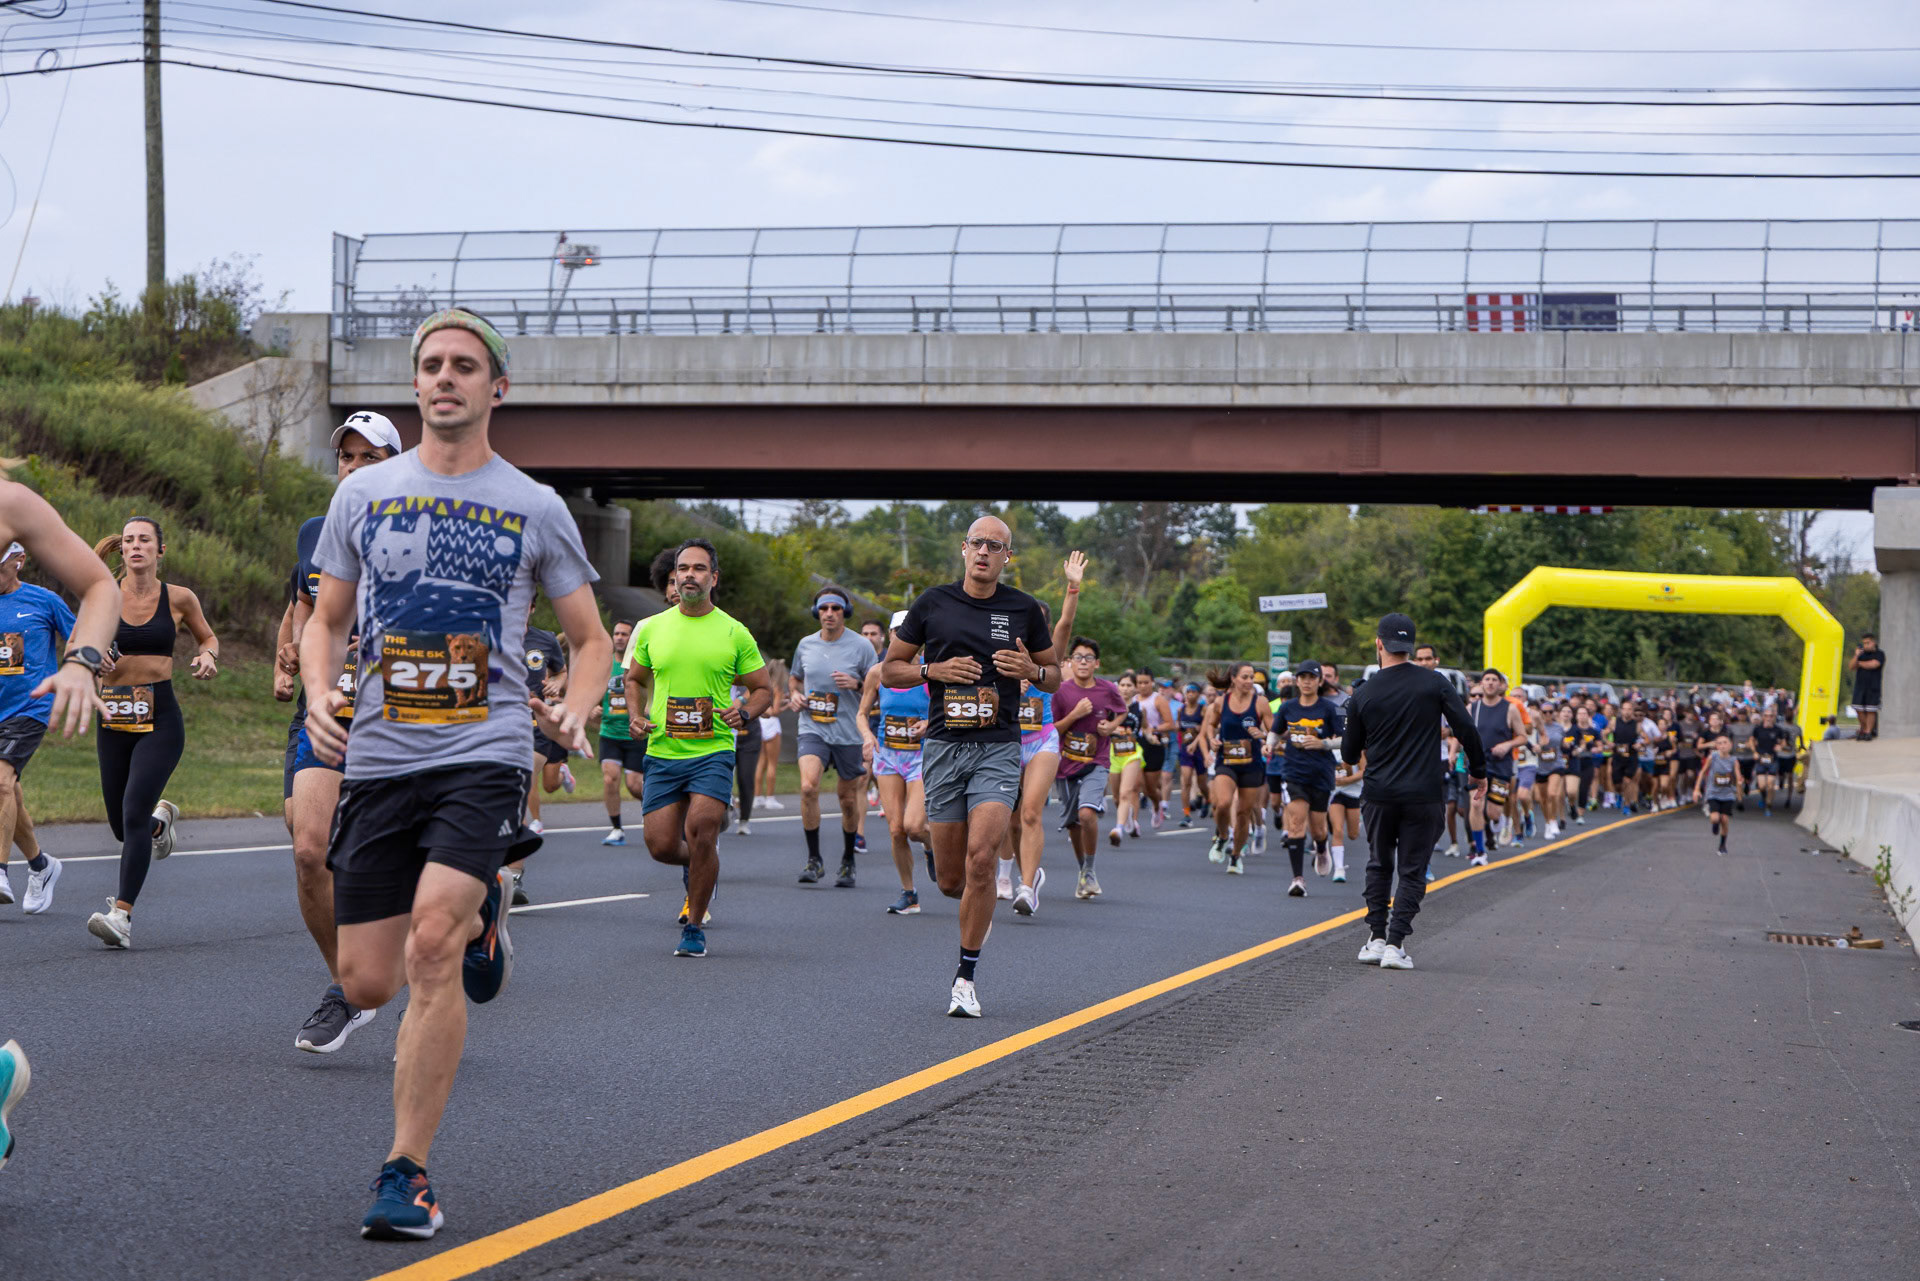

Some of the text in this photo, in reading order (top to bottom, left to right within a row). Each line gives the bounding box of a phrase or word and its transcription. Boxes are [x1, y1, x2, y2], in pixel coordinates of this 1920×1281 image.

[1262, 599, 1273, 608] 24
[384, 635, 407, 645] THE
[383, 647, 446, 658] CHASE 5K
[390, 661, 478, 689] 275
[337, 673, 358, 692] 4
[105, 701, 149, 715] 336
[947, 702, 993, 717] 335
[674, 711, 703, 723] 35
[1070, 741, 1089, 751] 37
[1229, 747, 1246, 755] 43
